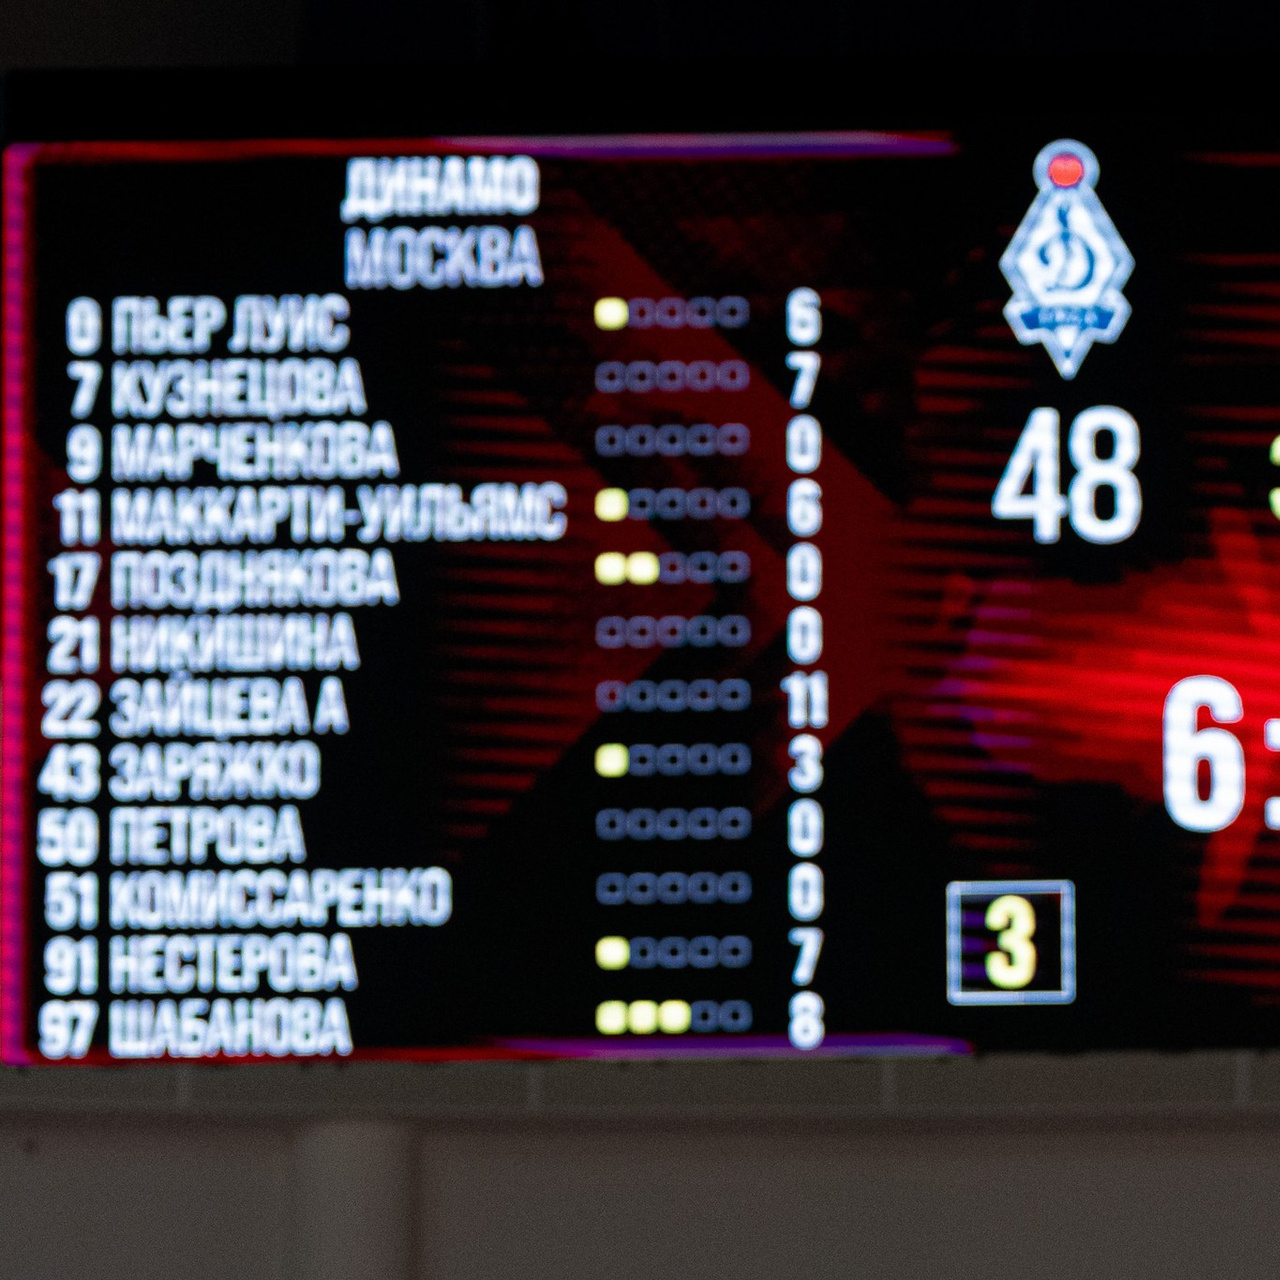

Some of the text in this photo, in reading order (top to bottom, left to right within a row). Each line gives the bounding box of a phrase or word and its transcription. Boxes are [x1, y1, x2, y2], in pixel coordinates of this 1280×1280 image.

[340, 155, 539, 221] ДИНАМО
[345, 225, 543, 288] МОСКВА
[66, 295, 349, 354] 0 ПЬЕР ЛУИС
[787, 289, 820, 343] 6
[67, 358, 367, 418] 7 КУЗНЕЦОВА
[787, 352, 820, 404] 7
[65, 421, 399, 481] 9 МАРЧЕНКОВА
[785, 416, 821, 473] 0
[991, 406, 1141, 542] 48
[51, 484, 567, 544] 11 МАККАРТИ-УИЛЬЯМС
[787, 478, 822, 536] 6
[47, 548, 399, 611] 17 ПОЗДНЯКОВА
[785, 543, 822, 601] 0
[46, 613, 360, 673] 21 НИКИШИНА
[787, 606, 822, 664] 0
[39, 672, 349, 738] 22 ЗАЙЦЕВА А
[784, 671, 828, 728] 11
[37, 743, 100, 800] 43
[789, 734, 822, 789] 3
[36, 805, 306, 865] 50 ПЕТРОВА
[788, 799, 823, 856] 0
[43, 867, 452, 929] 51 КОМИССАРЕНКО
[789, 863, 823, 918] 0
[42, 933, 358, 994] 91 НЕСТЕРОВА
[791, 928, 822, 982] 7
[982, 894, 1036, 990] 3
[38, 998, 352, 1059] 97 ШАБАНОВА
[789, 991, 824, 1050] 8
